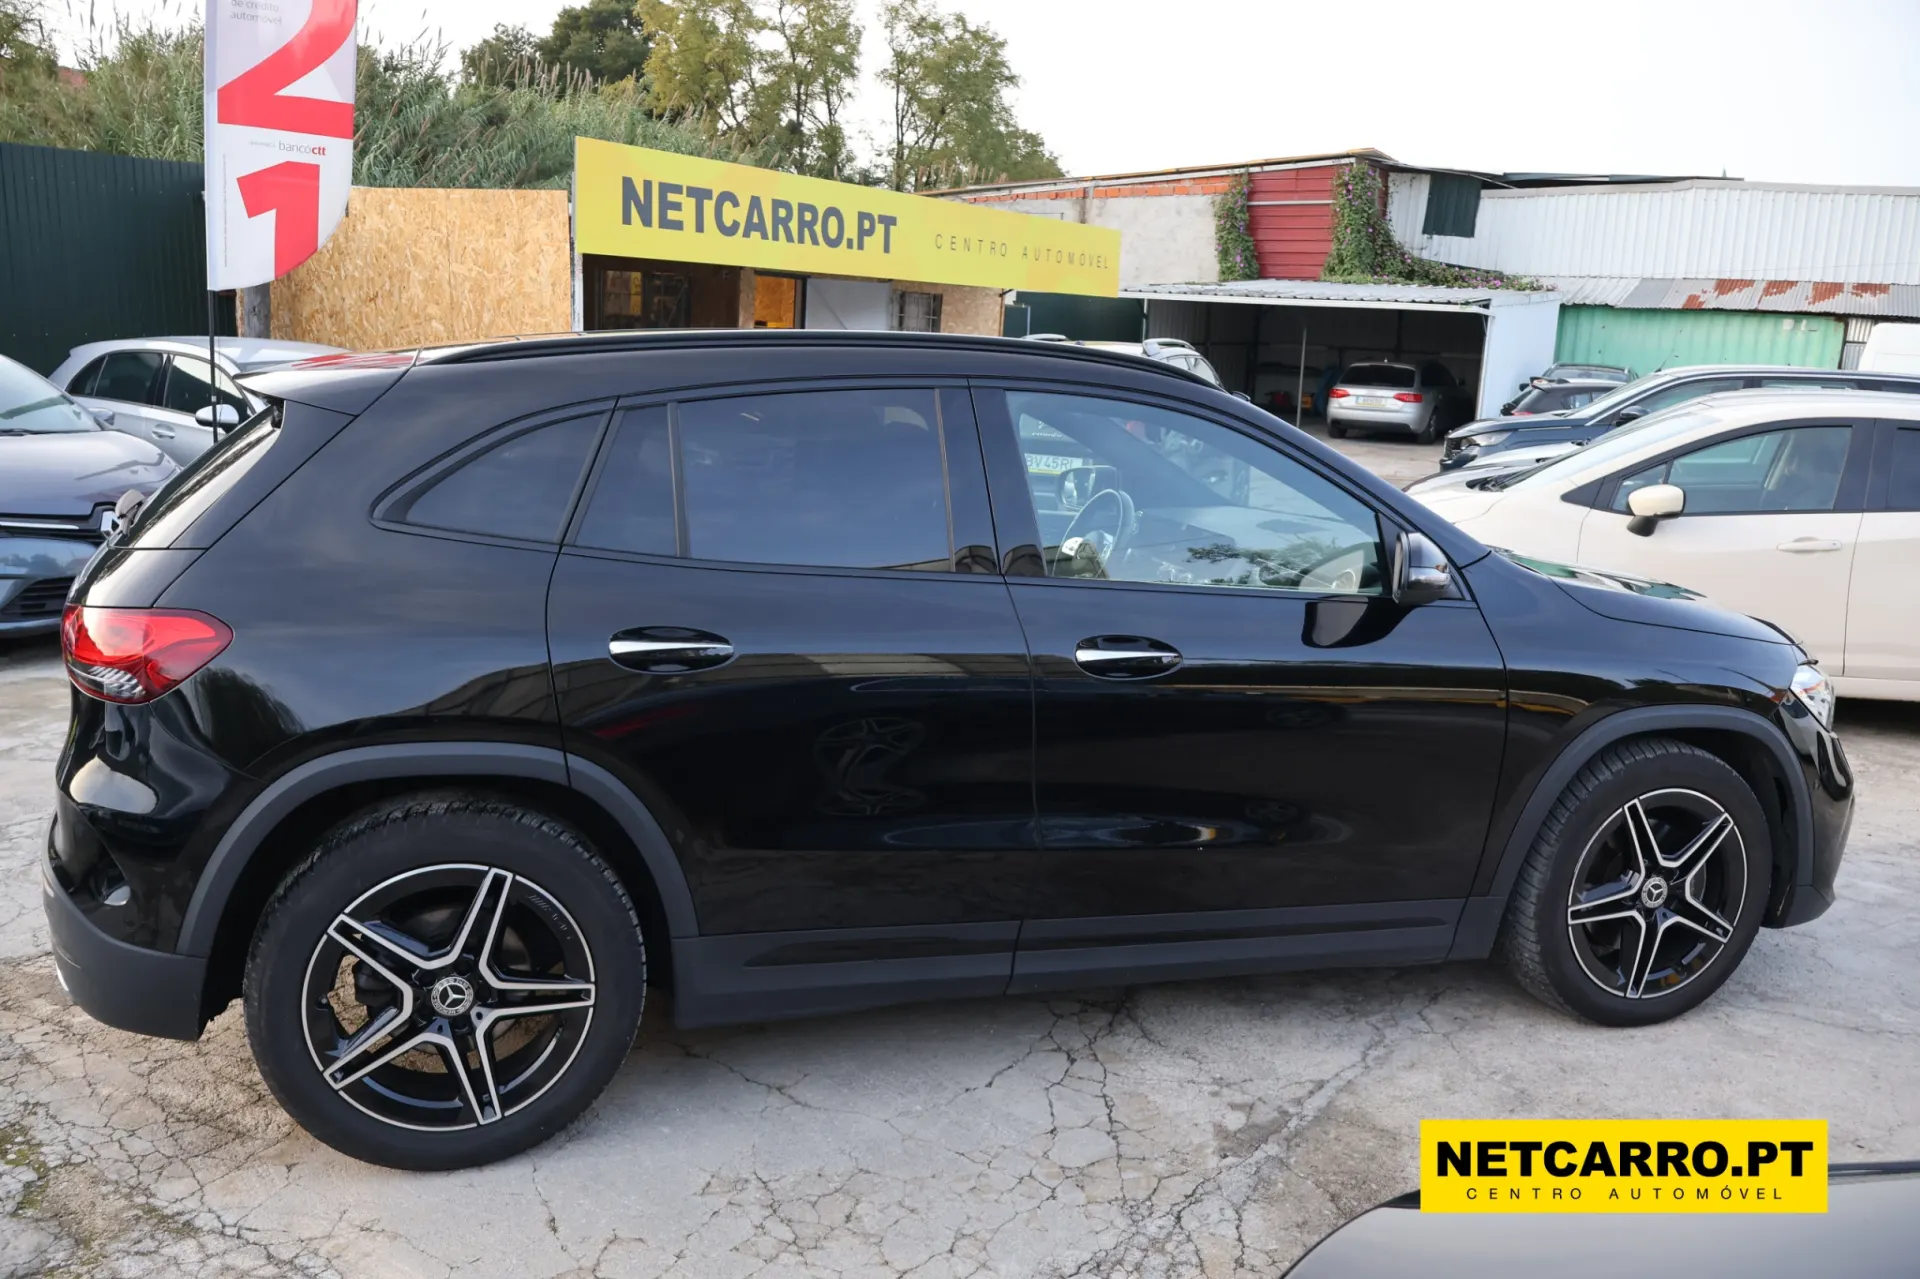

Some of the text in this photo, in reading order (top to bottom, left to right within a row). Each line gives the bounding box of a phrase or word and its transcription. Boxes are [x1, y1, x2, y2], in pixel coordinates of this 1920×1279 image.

[622, 176, 897, 254] NETCARRO.PT
[935, 233, 1109, 269] CENTRO AUTOMÓVEL
